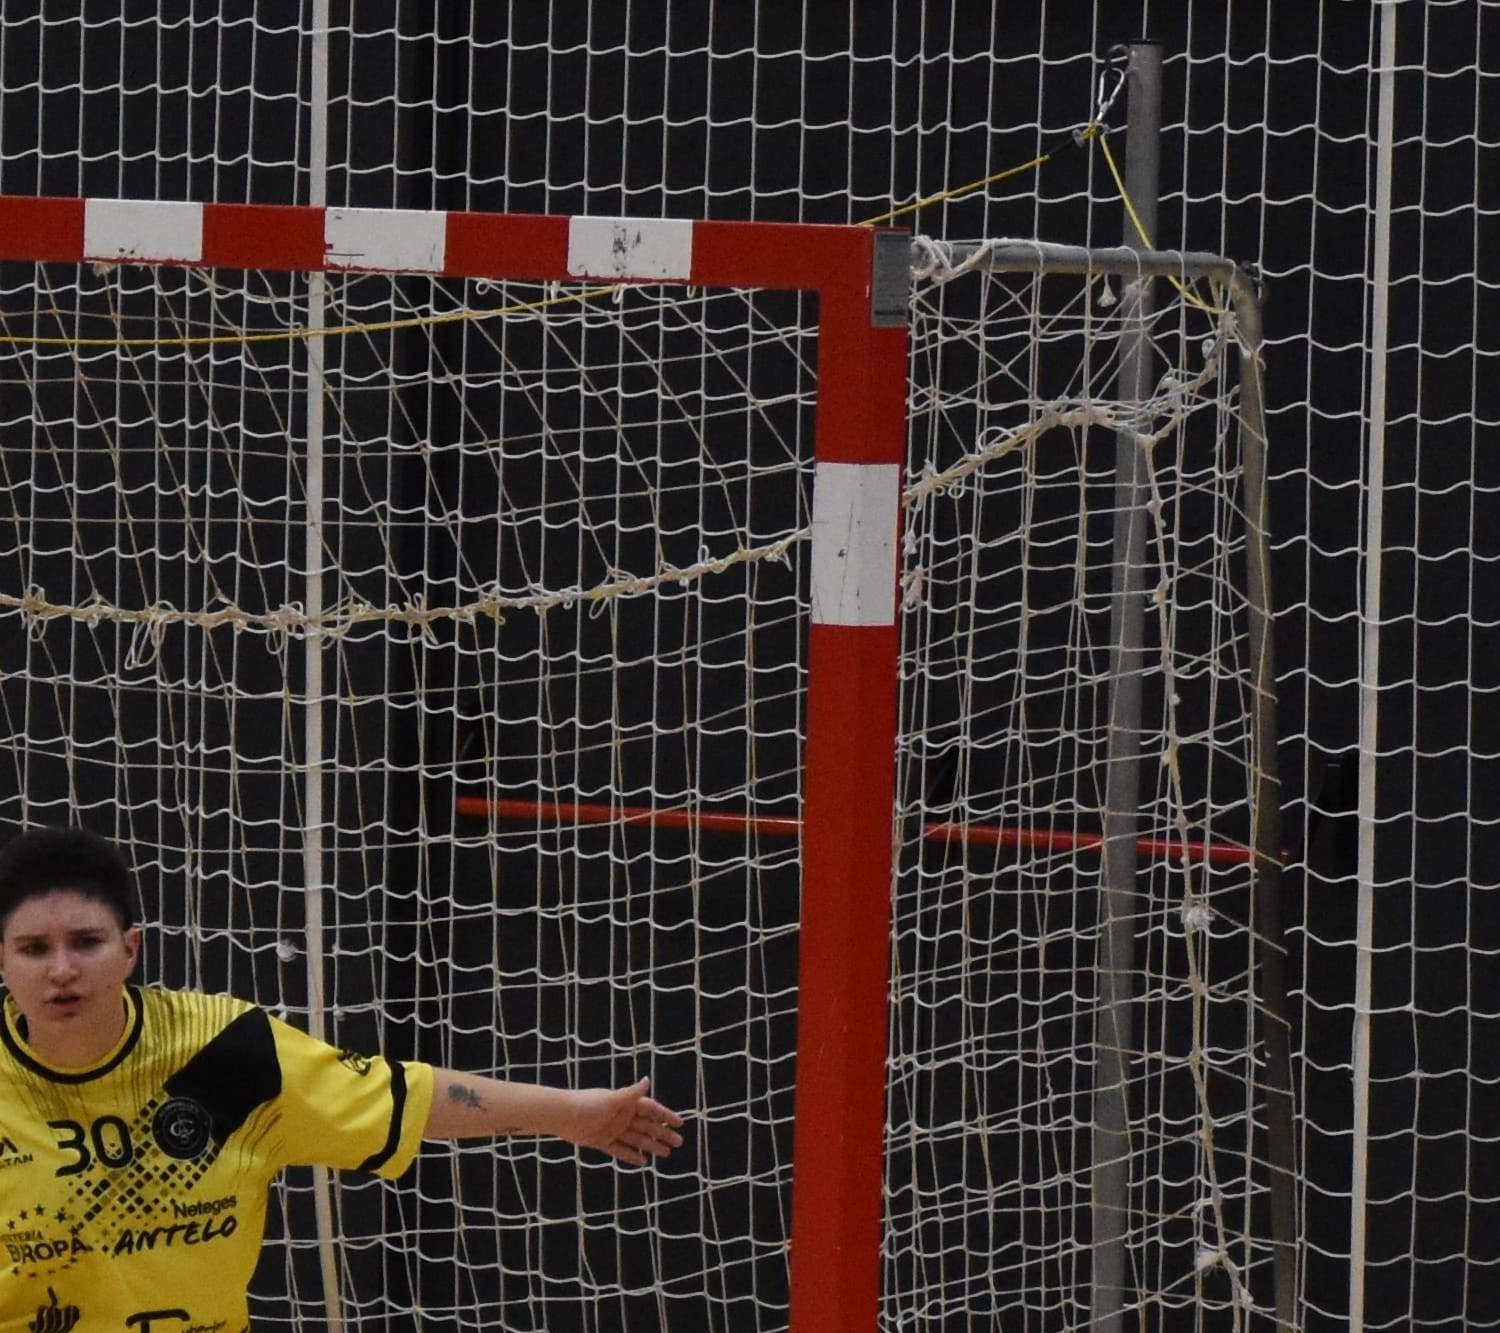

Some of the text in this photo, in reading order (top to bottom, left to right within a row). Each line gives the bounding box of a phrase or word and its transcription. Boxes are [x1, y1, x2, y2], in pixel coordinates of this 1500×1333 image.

[46, 1115, 133, 1177] 30
[173, 1195, 237, 1218] Neteges
[112, 1215, 237, 1256] ANTELO
